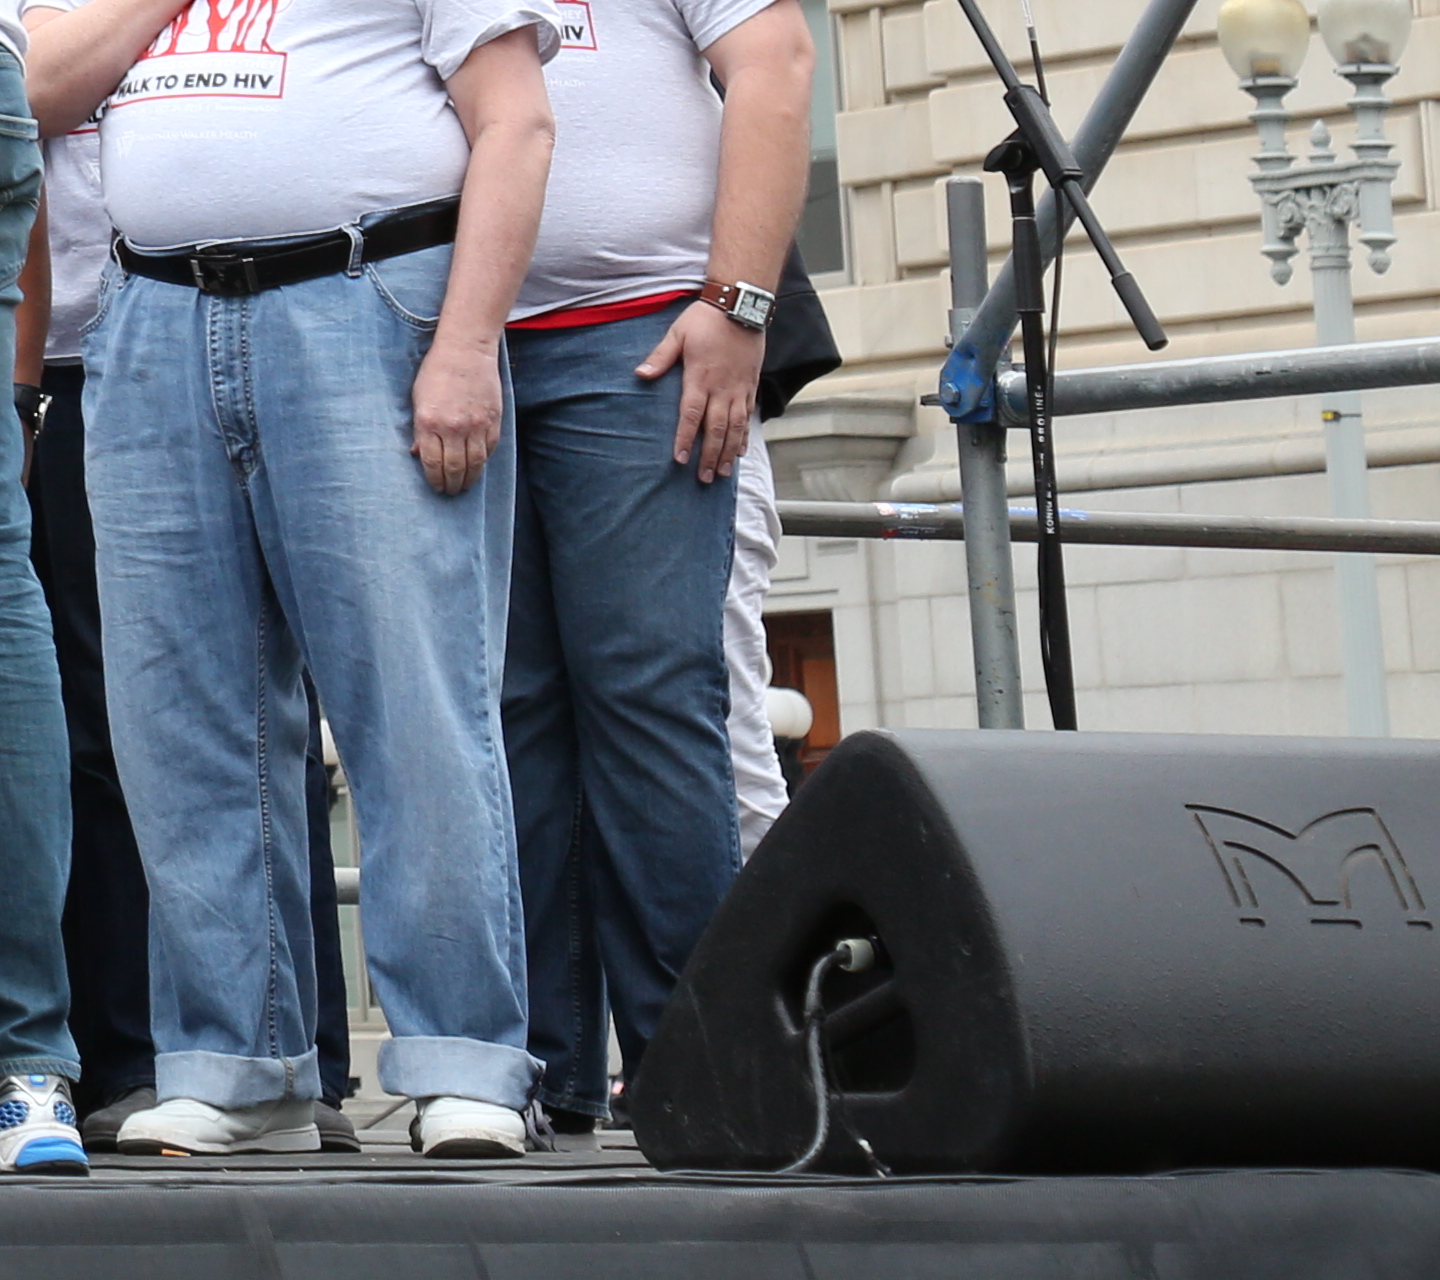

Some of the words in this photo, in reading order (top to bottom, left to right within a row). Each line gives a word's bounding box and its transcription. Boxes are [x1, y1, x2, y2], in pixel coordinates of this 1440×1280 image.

[561, 10, 582, 20] HEY
[155, 75, 178, 90] TO
[183, 72, 228, 89] END
[233, 72, 275, 90] HIV
